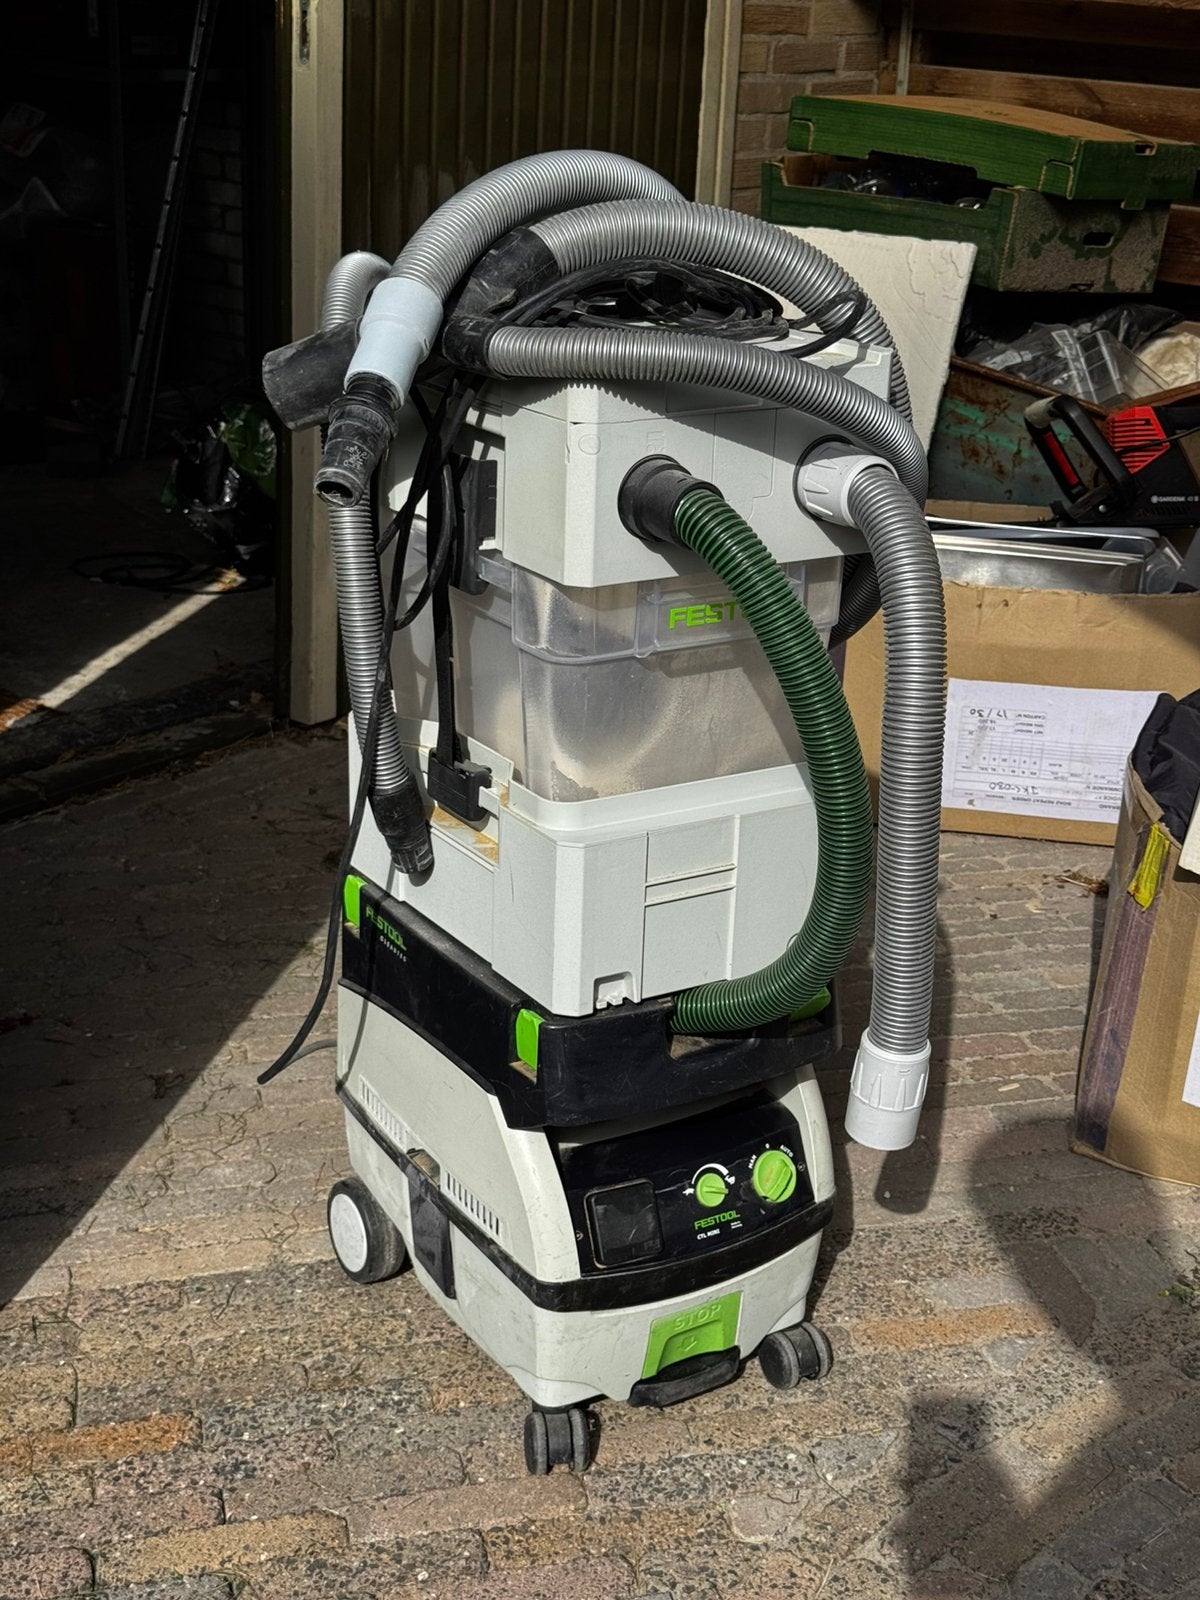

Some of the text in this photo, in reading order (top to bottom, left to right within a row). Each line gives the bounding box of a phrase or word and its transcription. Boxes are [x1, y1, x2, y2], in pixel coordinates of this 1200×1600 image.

[669, 601, 737, 630] FEST
[780, 1144, 794, 1158] AUTO
[694, 1210, 741, 1230] FESTOOL
[673, 1303, 721, 1331] STOP
